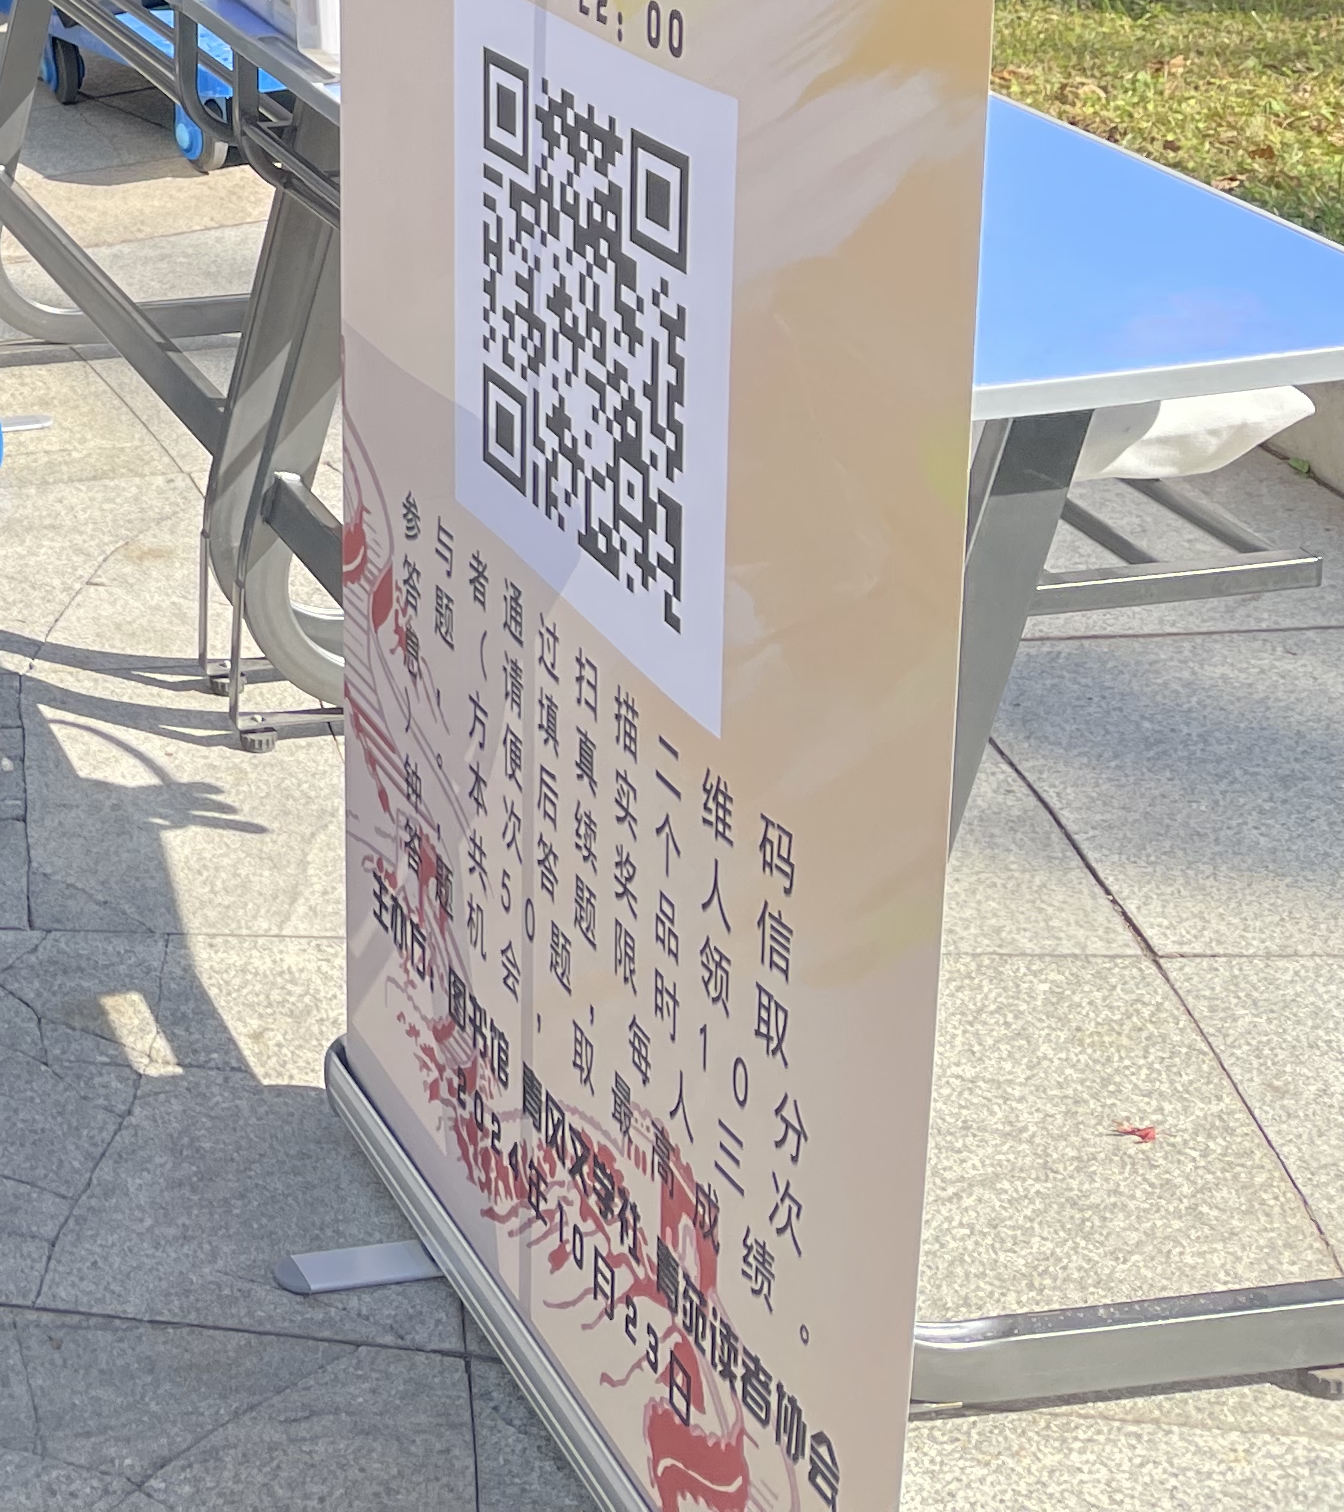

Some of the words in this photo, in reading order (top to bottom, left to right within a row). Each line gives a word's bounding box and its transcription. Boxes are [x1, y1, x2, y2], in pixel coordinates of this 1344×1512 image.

[400, 490, 795, 896] 参与者通过扫描二维码
[401, 556, 794, 984] 答题（请填真实个人信
[402, 618, 790, 1068] 息，方便后续奖品领取
[455, 1067, 692, 1427] 2024年10月23日
